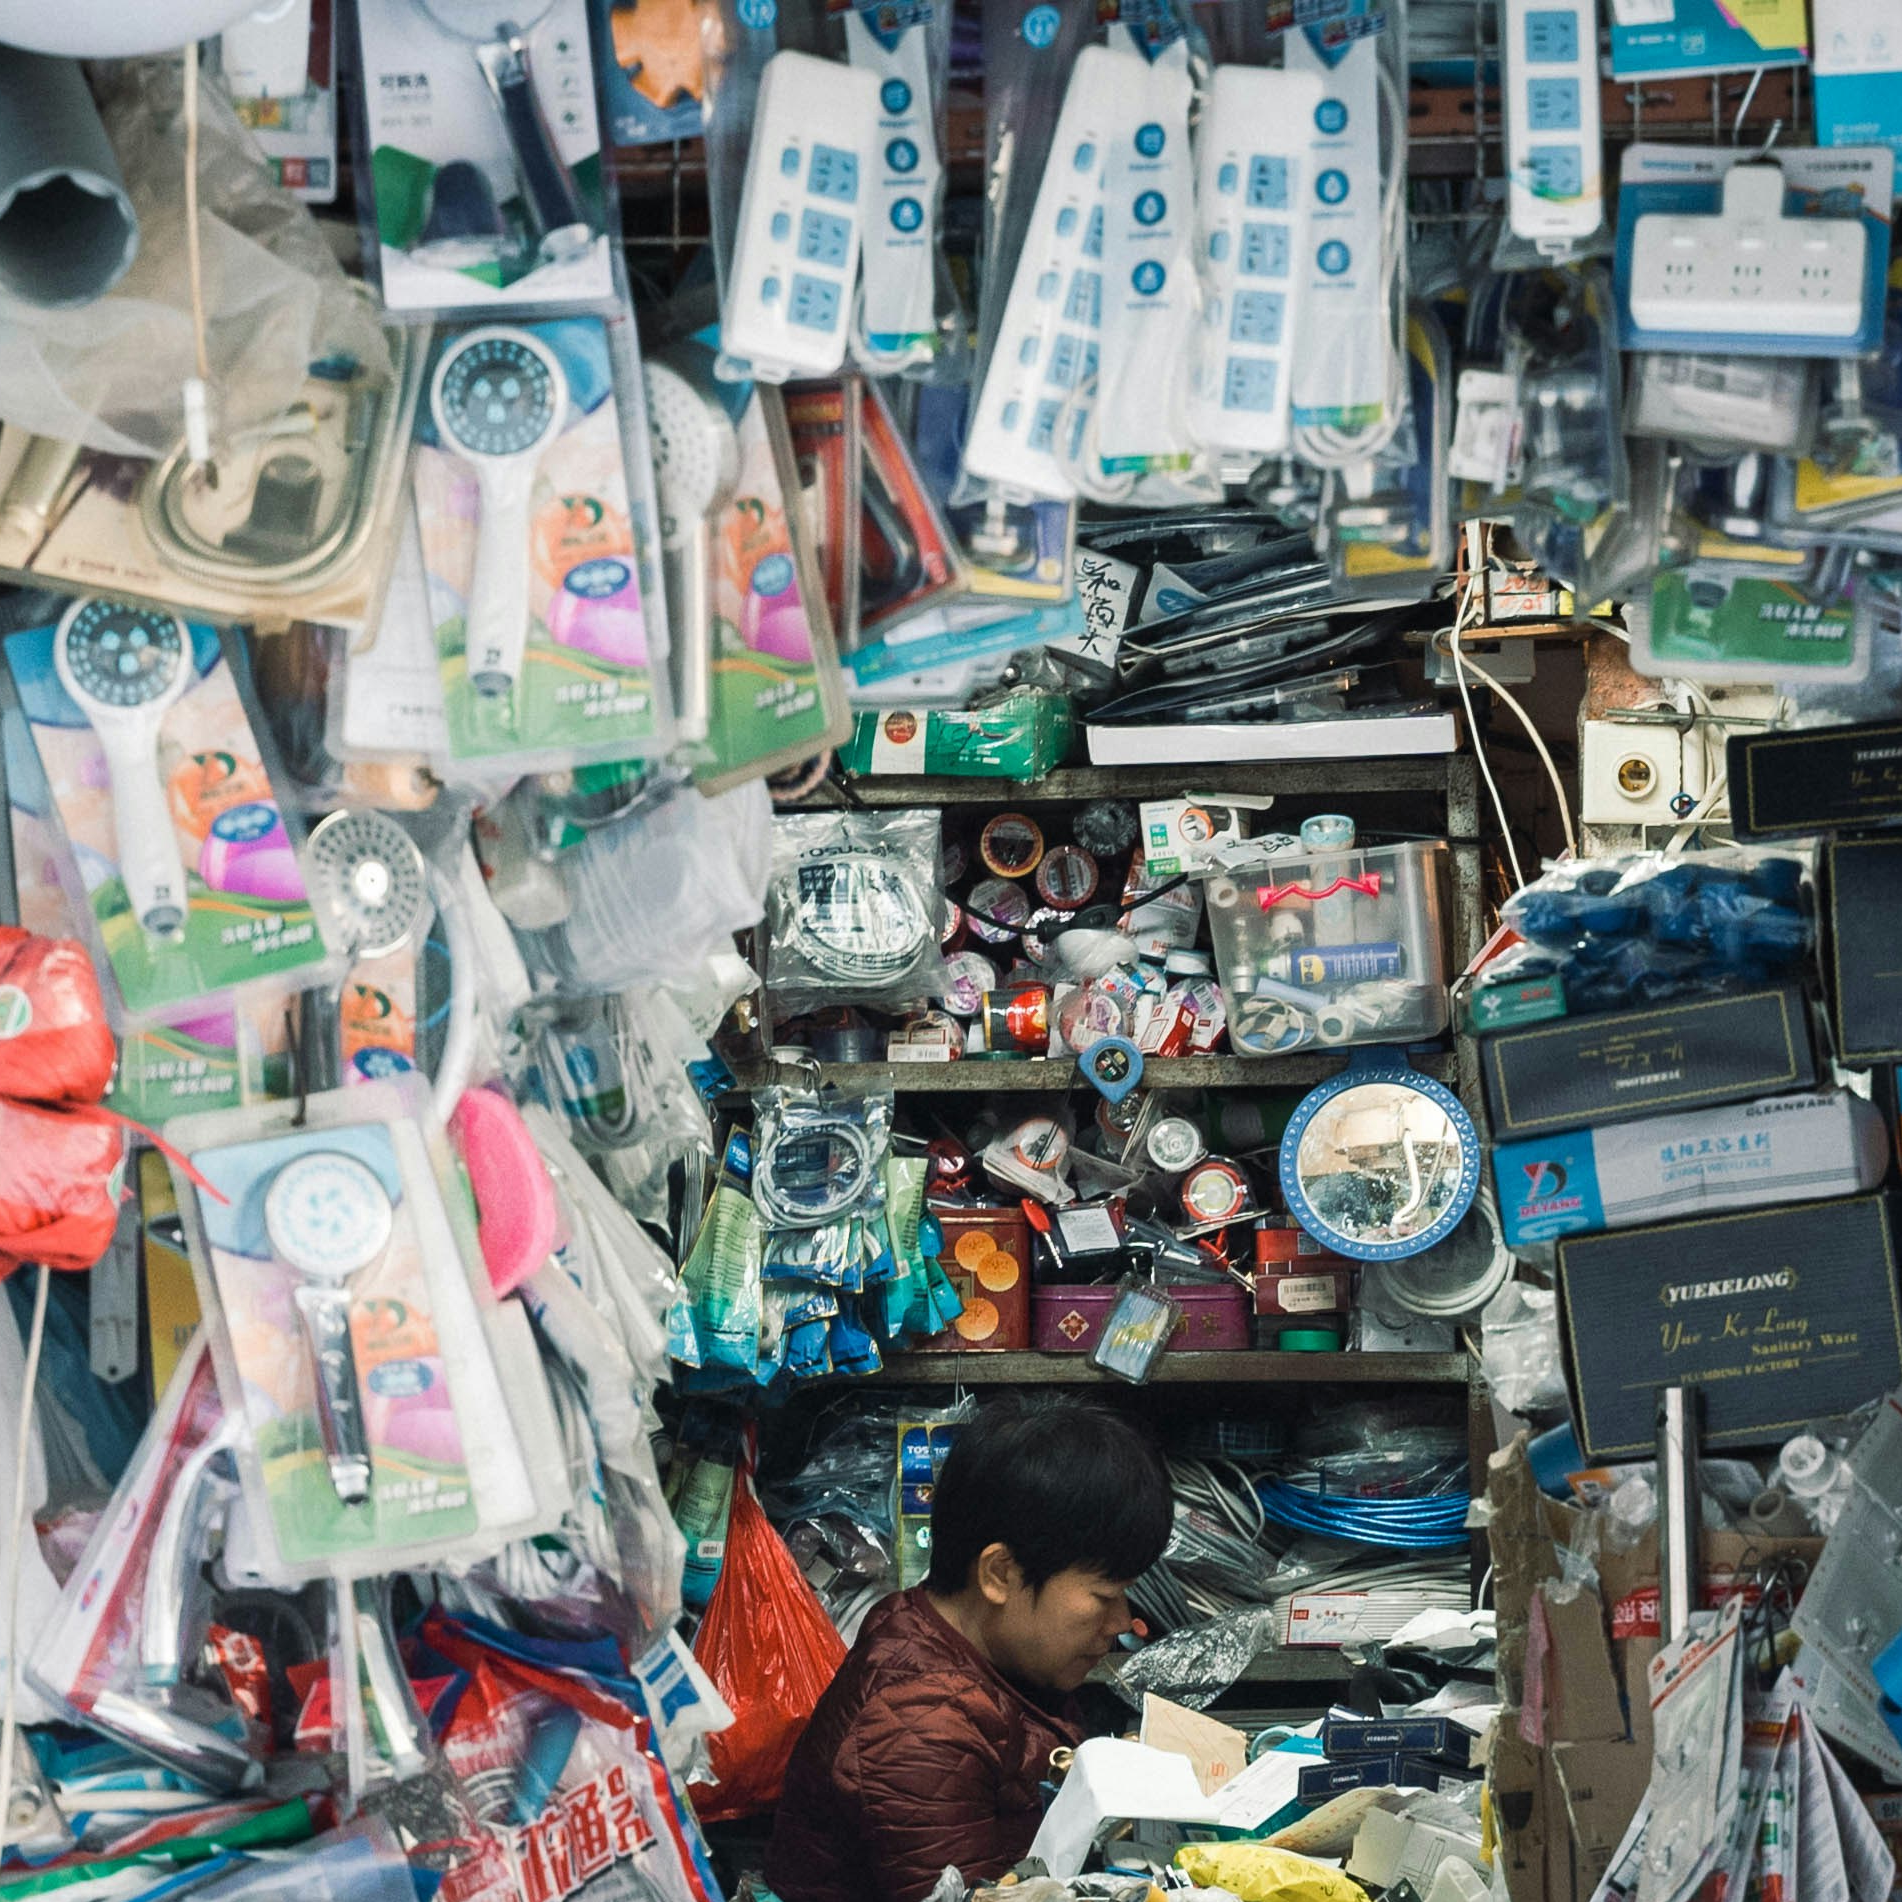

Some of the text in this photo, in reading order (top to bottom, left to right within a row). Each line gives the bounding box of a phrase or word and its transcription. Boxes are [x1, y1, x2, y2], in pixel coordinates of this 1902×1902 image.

[1520, 1196, 1583, 1218] DEYANG
[1667, 1270, 1790, 1304] YUEKELONG
[1659, 1320, 1702, 1355] Yue
[1754, 1306, 1809, 1336] Long
